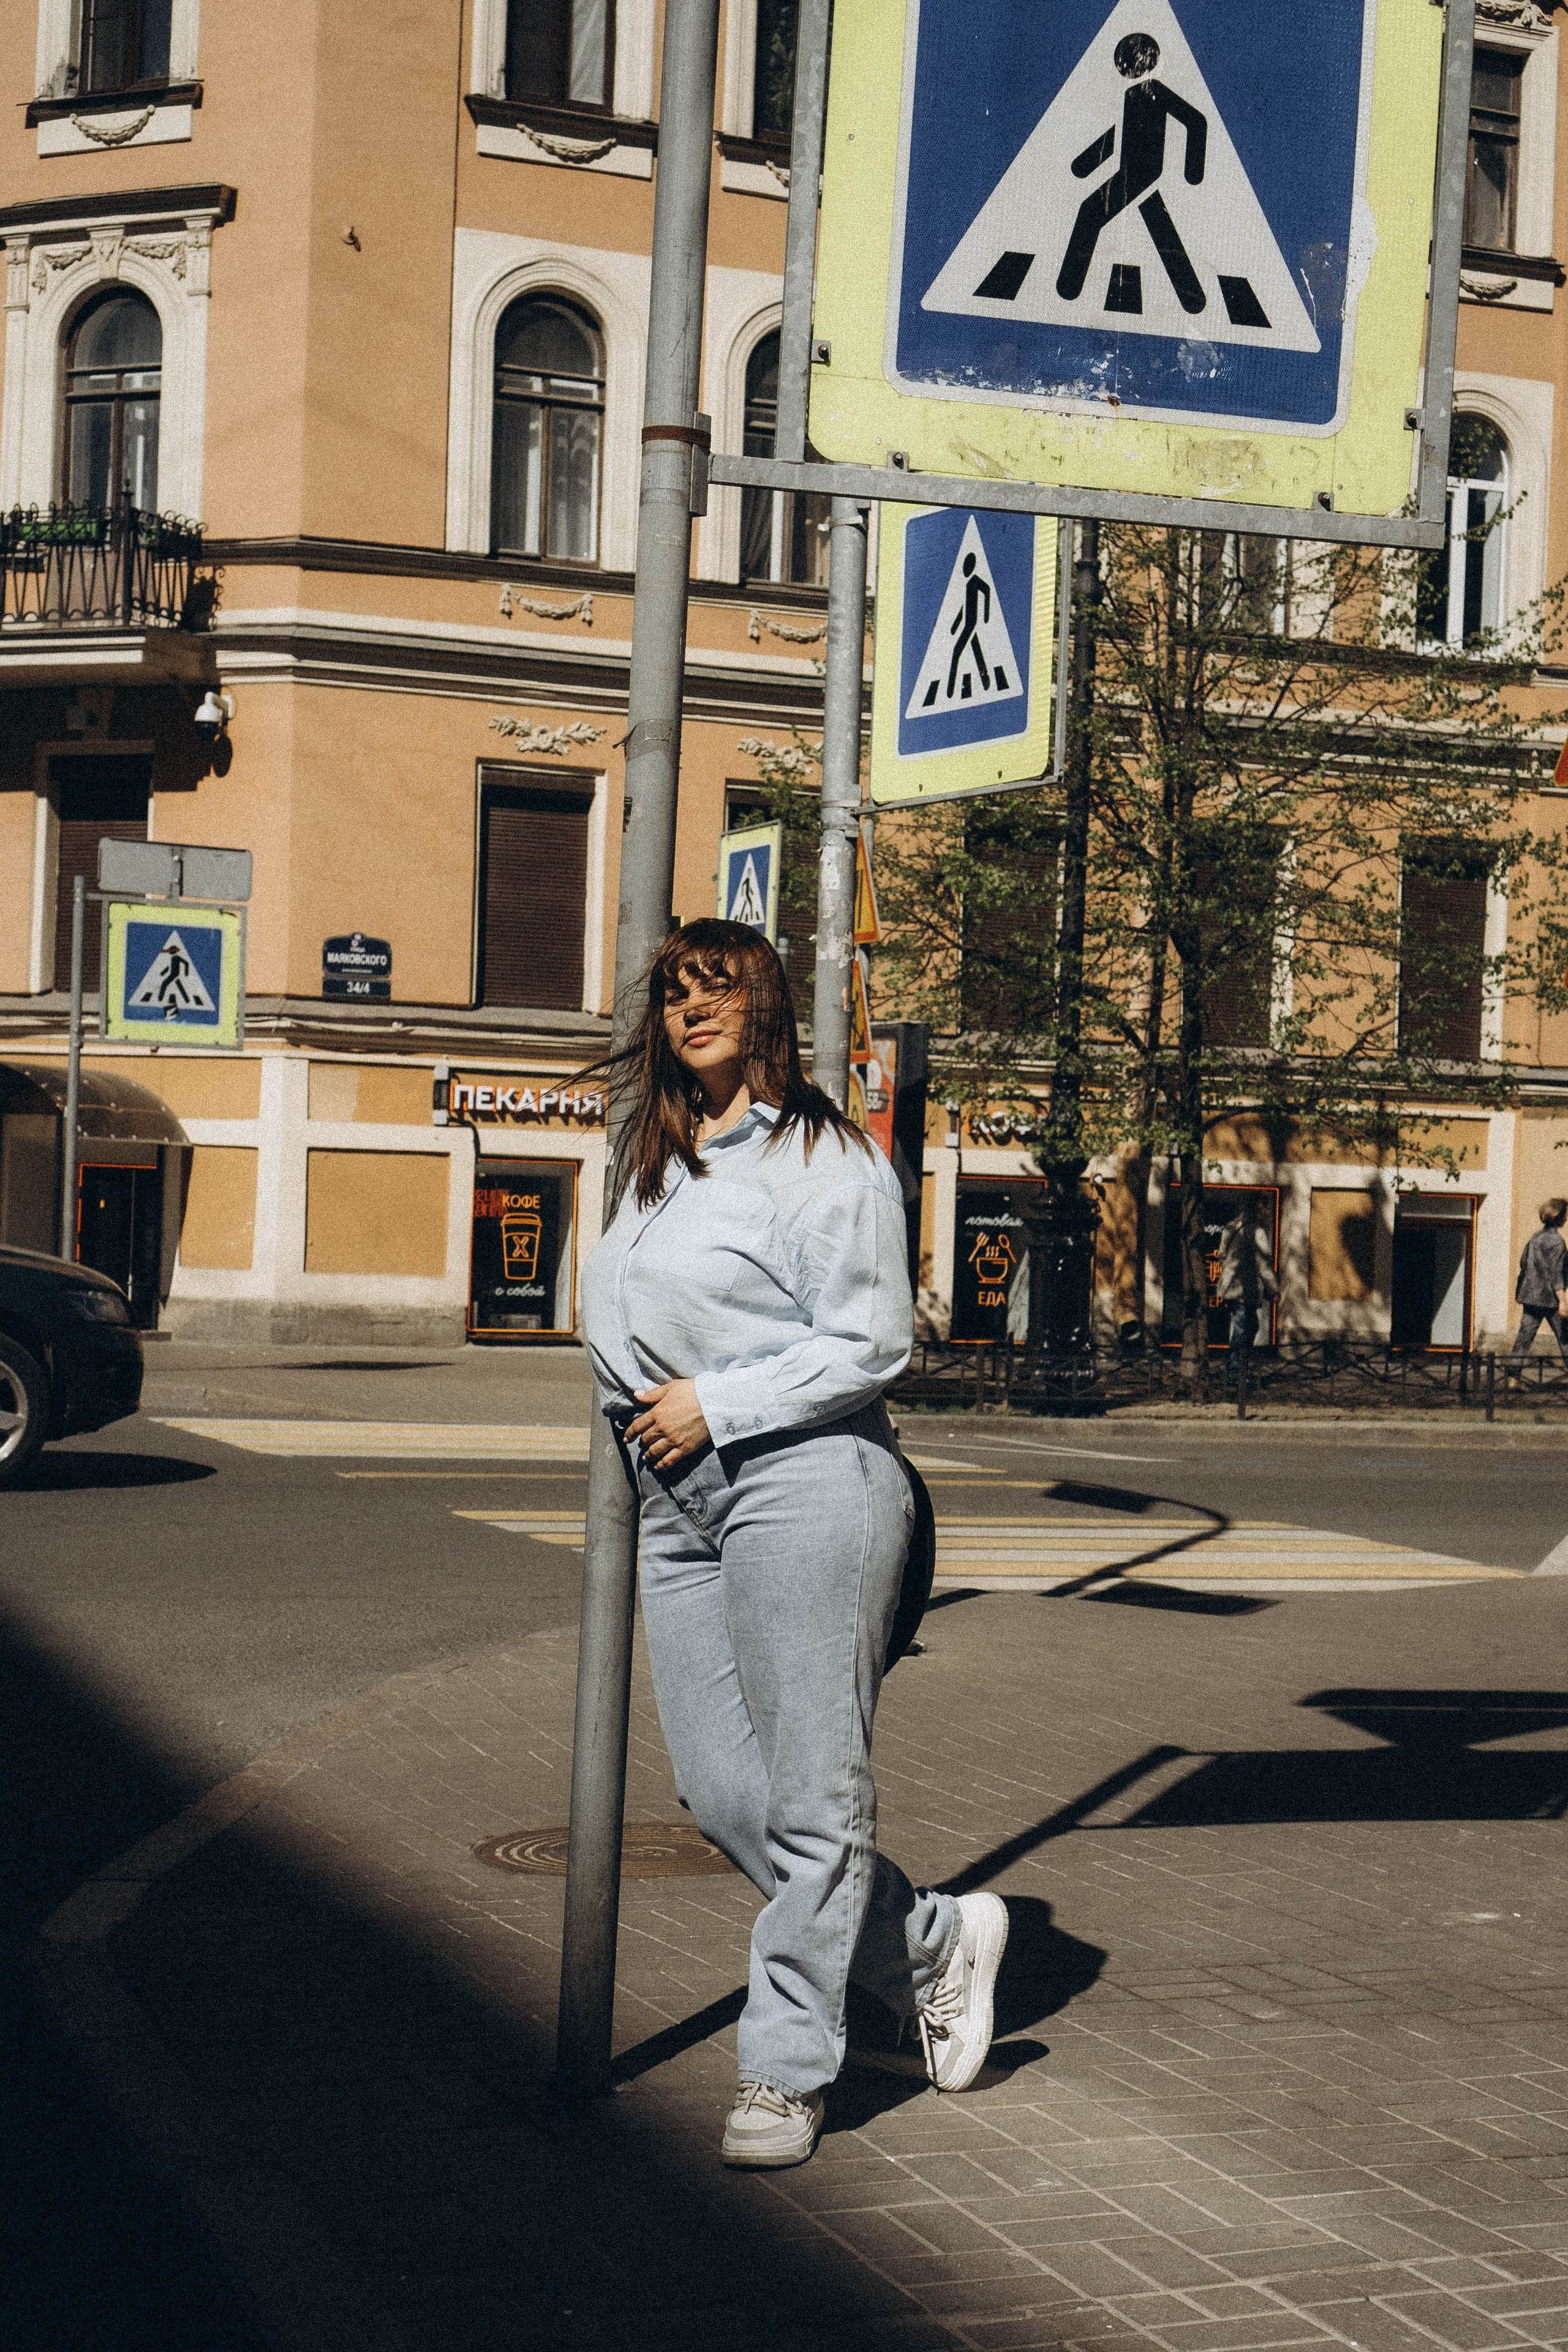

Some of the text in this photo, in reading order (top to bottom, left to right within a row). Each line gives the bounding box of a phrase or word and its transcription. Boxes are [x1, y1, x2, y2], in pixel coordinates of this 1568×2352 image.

[327, 952, 388, 966] МАЯКОВСКОГО
[347, 981, 370, 993] 34/4
[450, 1084, 603, 1115] ПЕКАРНЯ
[502, 1195, 541, 1208] КОФЕ
[978, 1291, 1006, 1306] ЕДА
